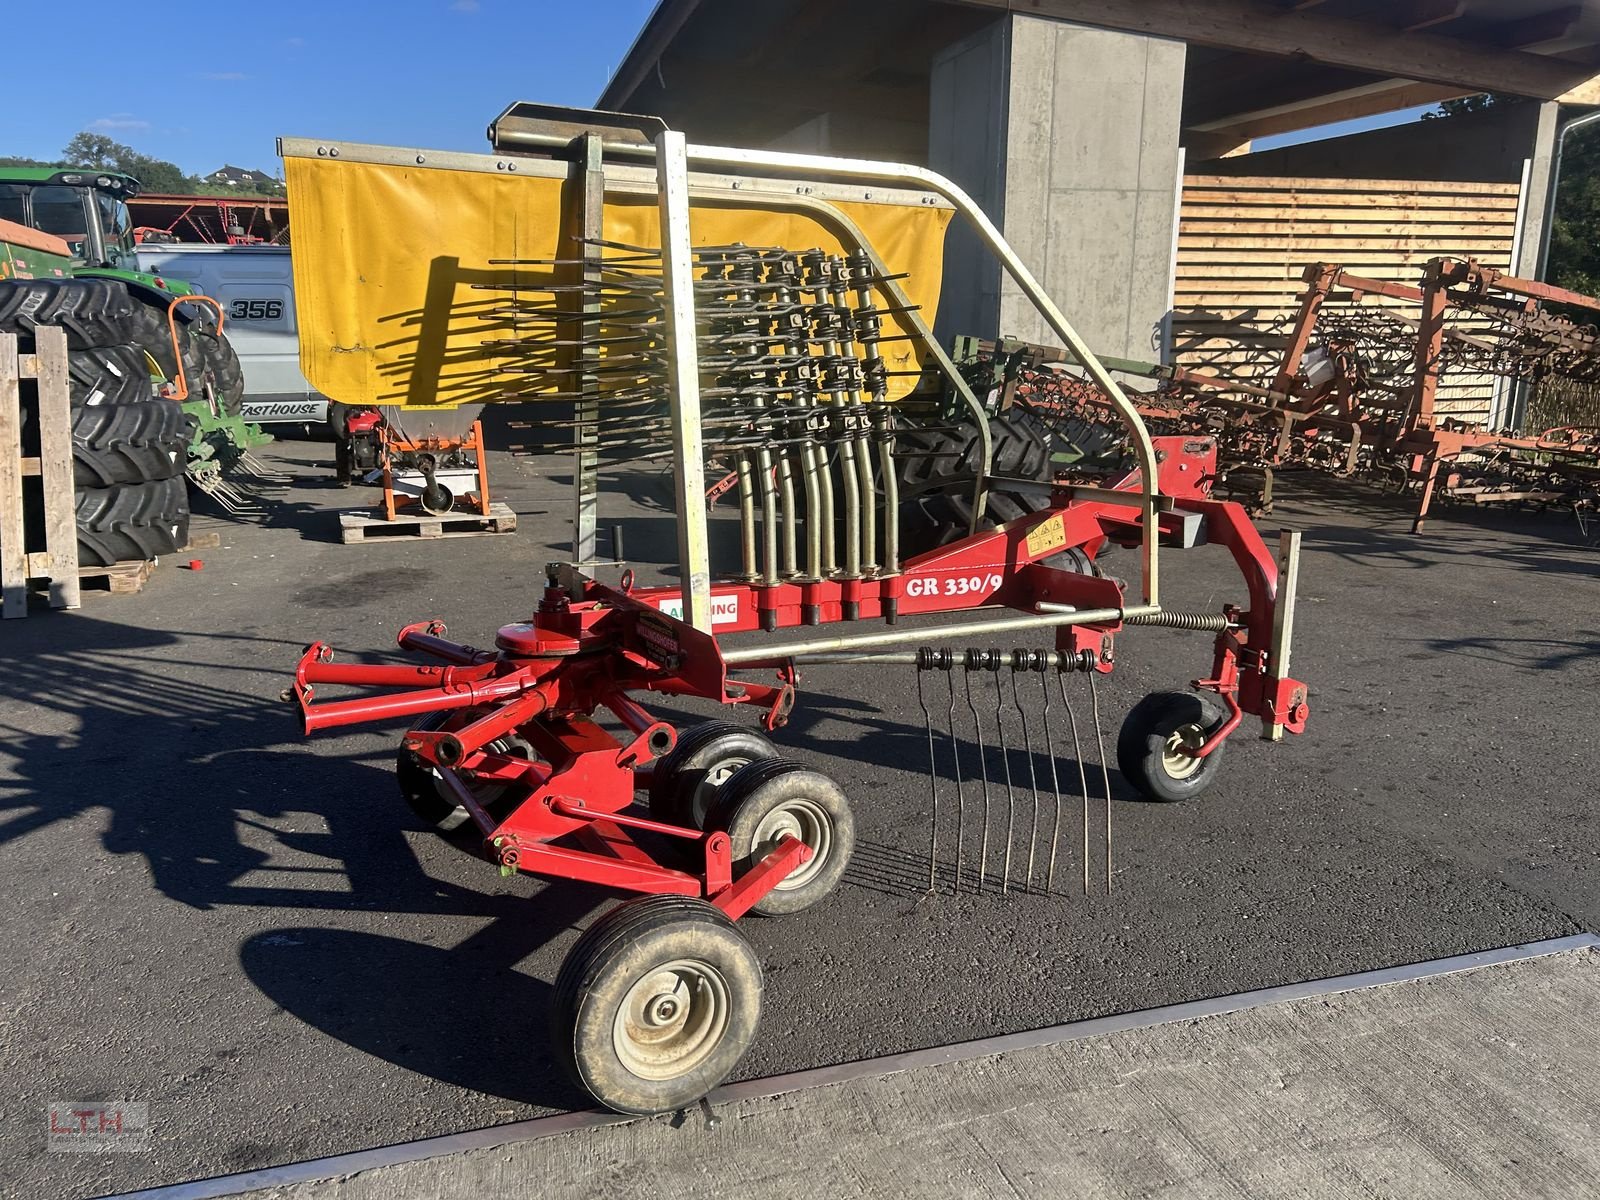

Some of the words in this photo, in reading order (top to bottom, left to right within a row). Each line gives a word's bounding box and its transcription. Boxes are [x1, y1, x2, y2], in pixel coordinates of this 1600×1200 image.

[230, 299, 284, 320] 356
[240, 403, 320, 416] FASTHOUSE
[906, 576, 939, 597] GR
[944, 573, 1003, 596] 330/9
